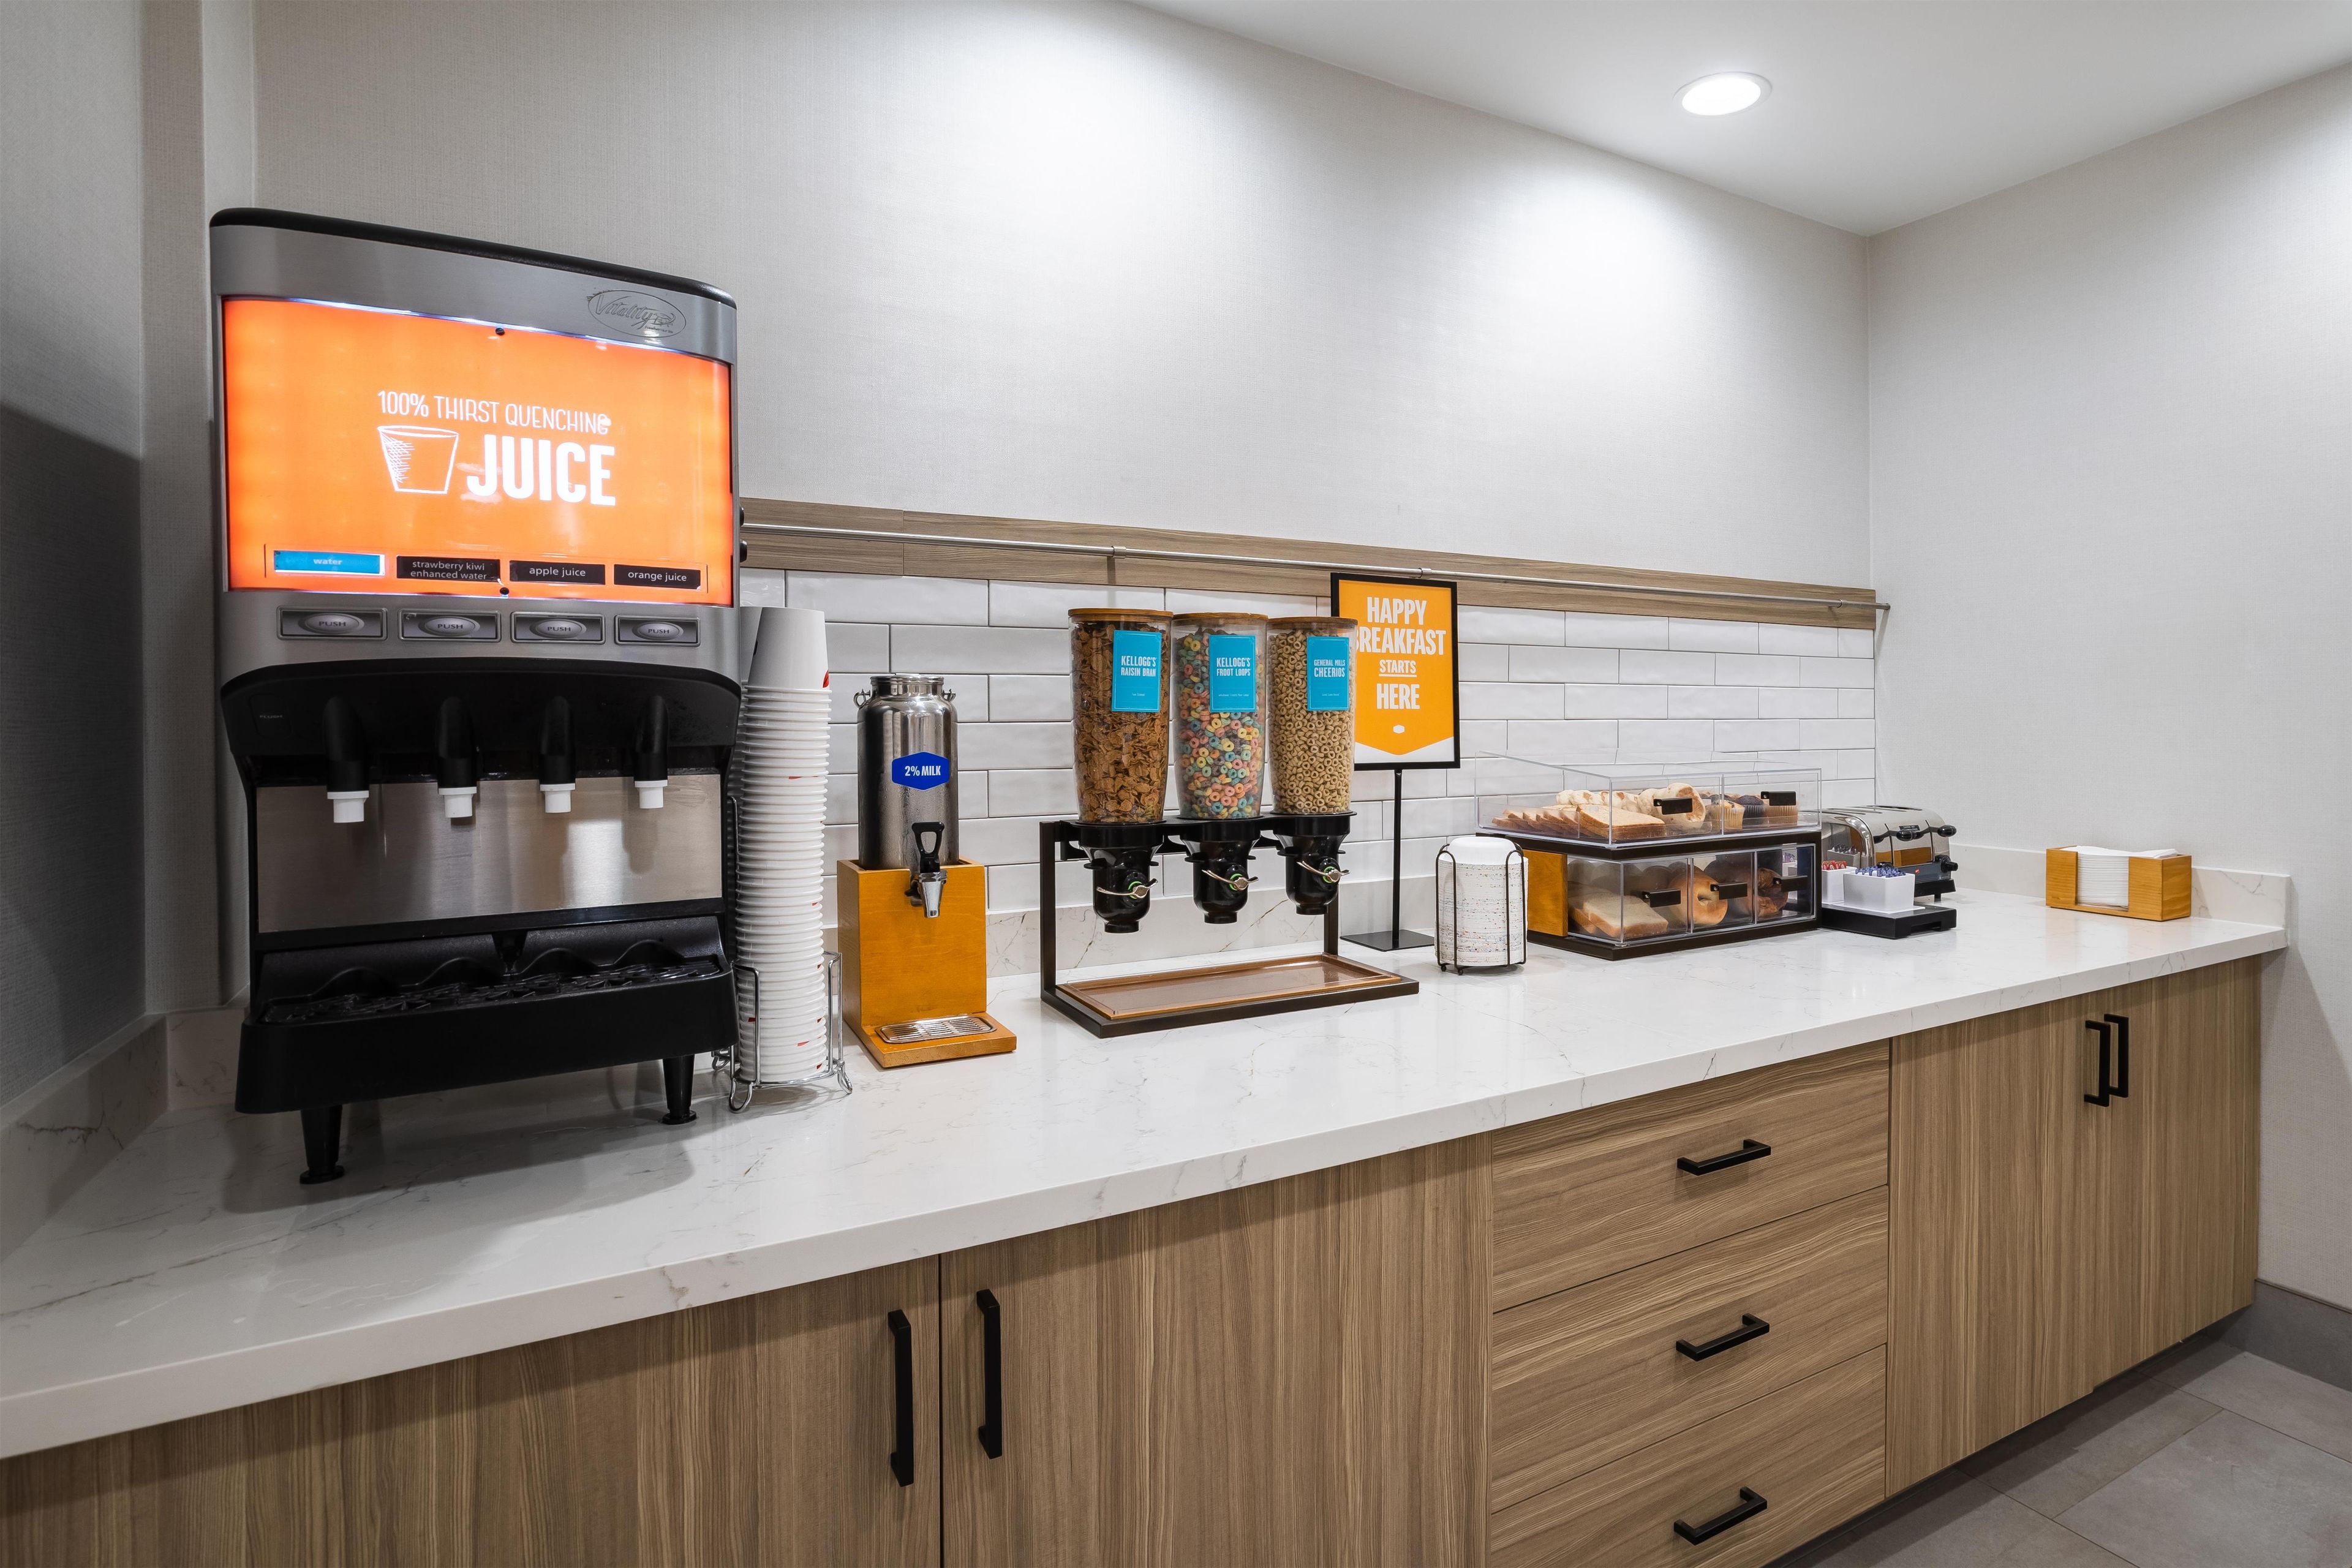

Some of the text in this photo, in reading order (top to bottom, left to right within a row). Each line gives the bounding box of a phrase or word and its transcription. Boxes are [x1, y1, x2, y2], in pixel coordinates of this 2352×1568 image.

[377, 390, 611, 435] 100% THIRST QUENCHING
[466, 434, 616, 507] JUICE
[412, 560, 485, 571] strawberry kiwi
[410, 570, 458, 579] enhanced
[529, 566, 586, 578] apple juice
[628, 570, 687, 582] orange juice
[1366, 597, 1427, 625] HAPPY
[1355, 626, 1446, 655] REAKFAST
[1121, 655, 1156, 667] KELLOGG'S
[1216, 657, 1251, 667] KELLOGG'S
[1379, 659, 1417, 674] STARTS
[1120, 667, 1156, 677] RAISIN BRAN
[1314, 667, 1346, 677] CHEERIOS
[1376, 683, 1420, 710] HERE
[904, 765, 941, 777] 2% MILK
